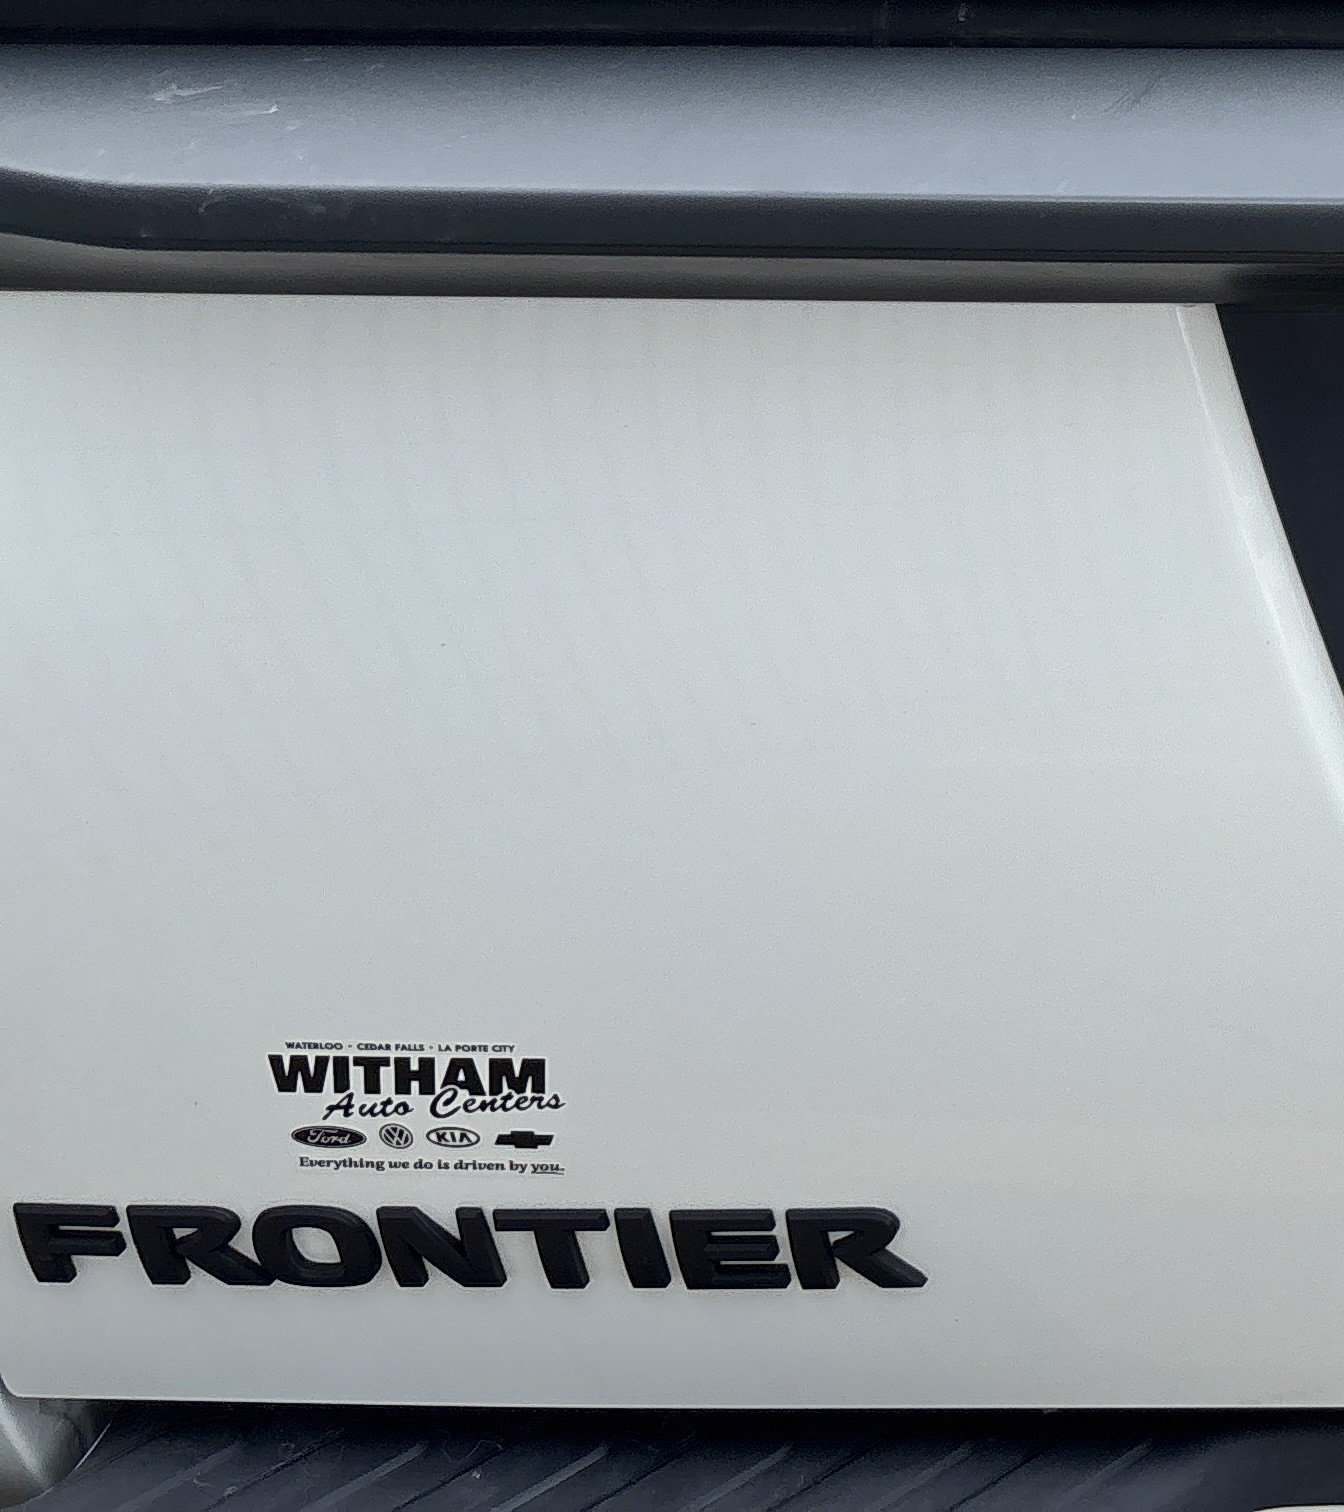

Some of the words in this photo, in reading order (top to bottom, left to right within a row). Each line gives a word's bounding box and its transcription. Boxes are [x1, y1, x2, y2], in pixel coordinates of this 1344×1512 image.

[285, 1041, 344, 1051] WATERLOO
[356, 1042, 391, 1052] CEDAR
[394, 1043, 425, 1052] FALLS
[438, 1043, 453, 1052] LA
[455, 1044, 489, 1053] PORTE
[491, 1044, 516, 1053] CITY
[267, 1053, 547, 1096] WITHAM
[321, 1091, 415, 1120] Auto
[429, 1087, 567, 1118] Centers
[434, 1131, 473, 1143] KIA
[299, 1156, 386, 1171] Everything
[387, 1159, 410, 1170] we
[412, 1158, 434, 1170] do
[437, 1159, 450, 1170] is
[453, 1159, 507, 1171] driven
[508, 1160, 528, 1174] by
[13, 1202, 929, 1291] FRONTIER
